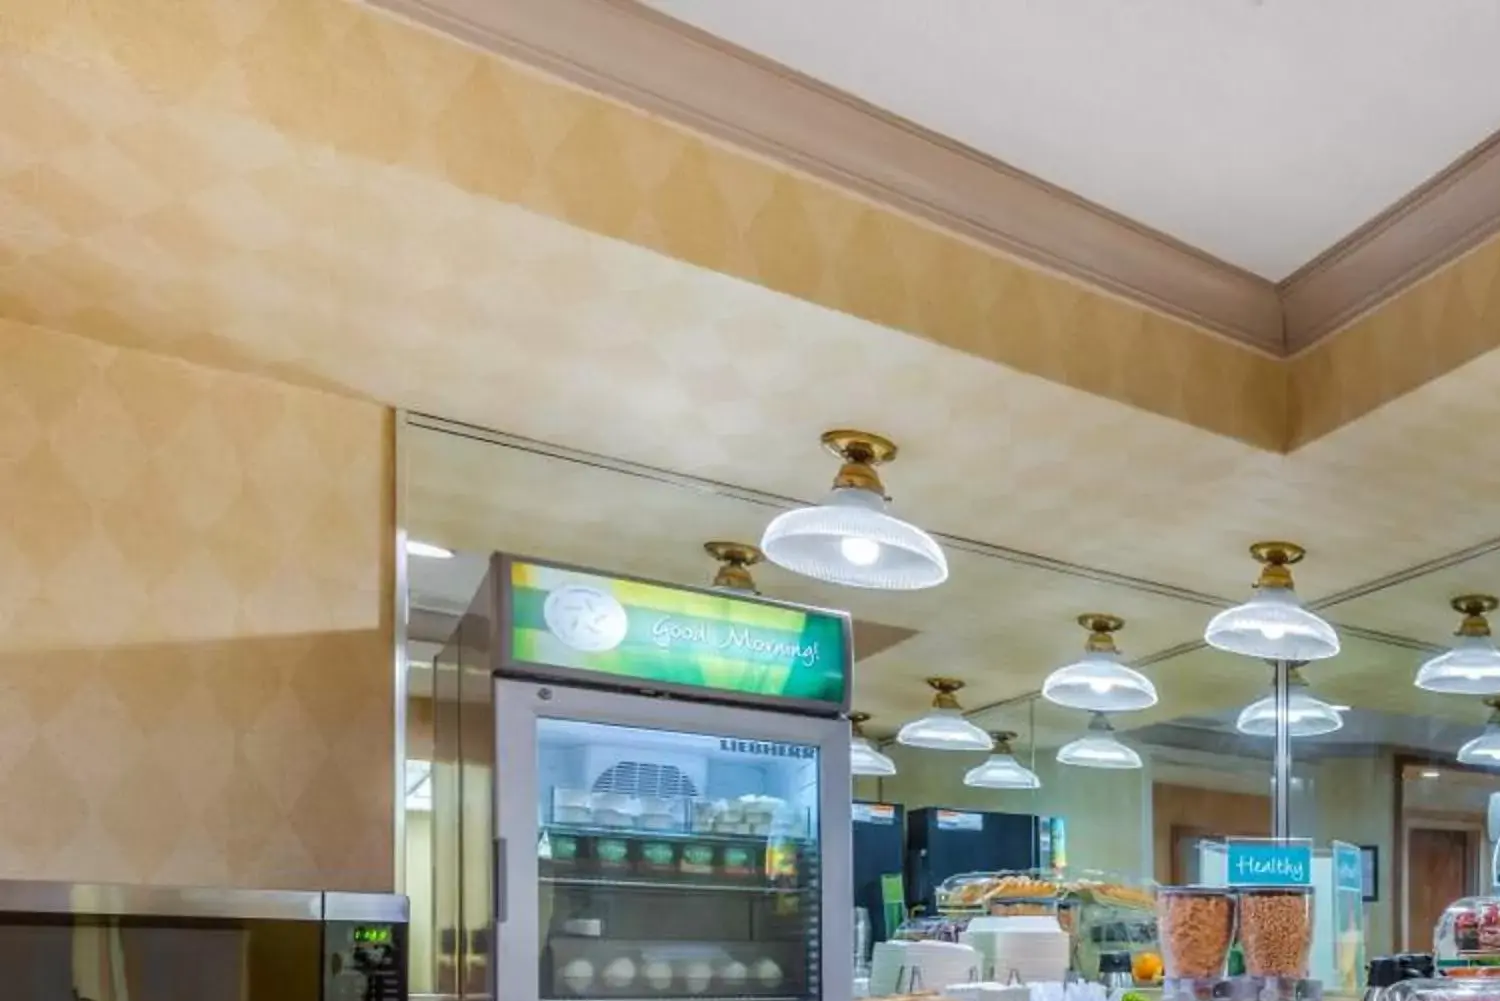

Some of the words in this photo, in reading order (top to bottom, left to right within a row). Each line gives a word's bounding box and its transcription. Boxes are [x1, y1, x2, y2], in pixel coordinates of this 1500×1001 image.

[652, 615, 706, 647] Good
[719, 625, 820, 667] Morning!
[1236, 855, 1304, 881] Healthy
